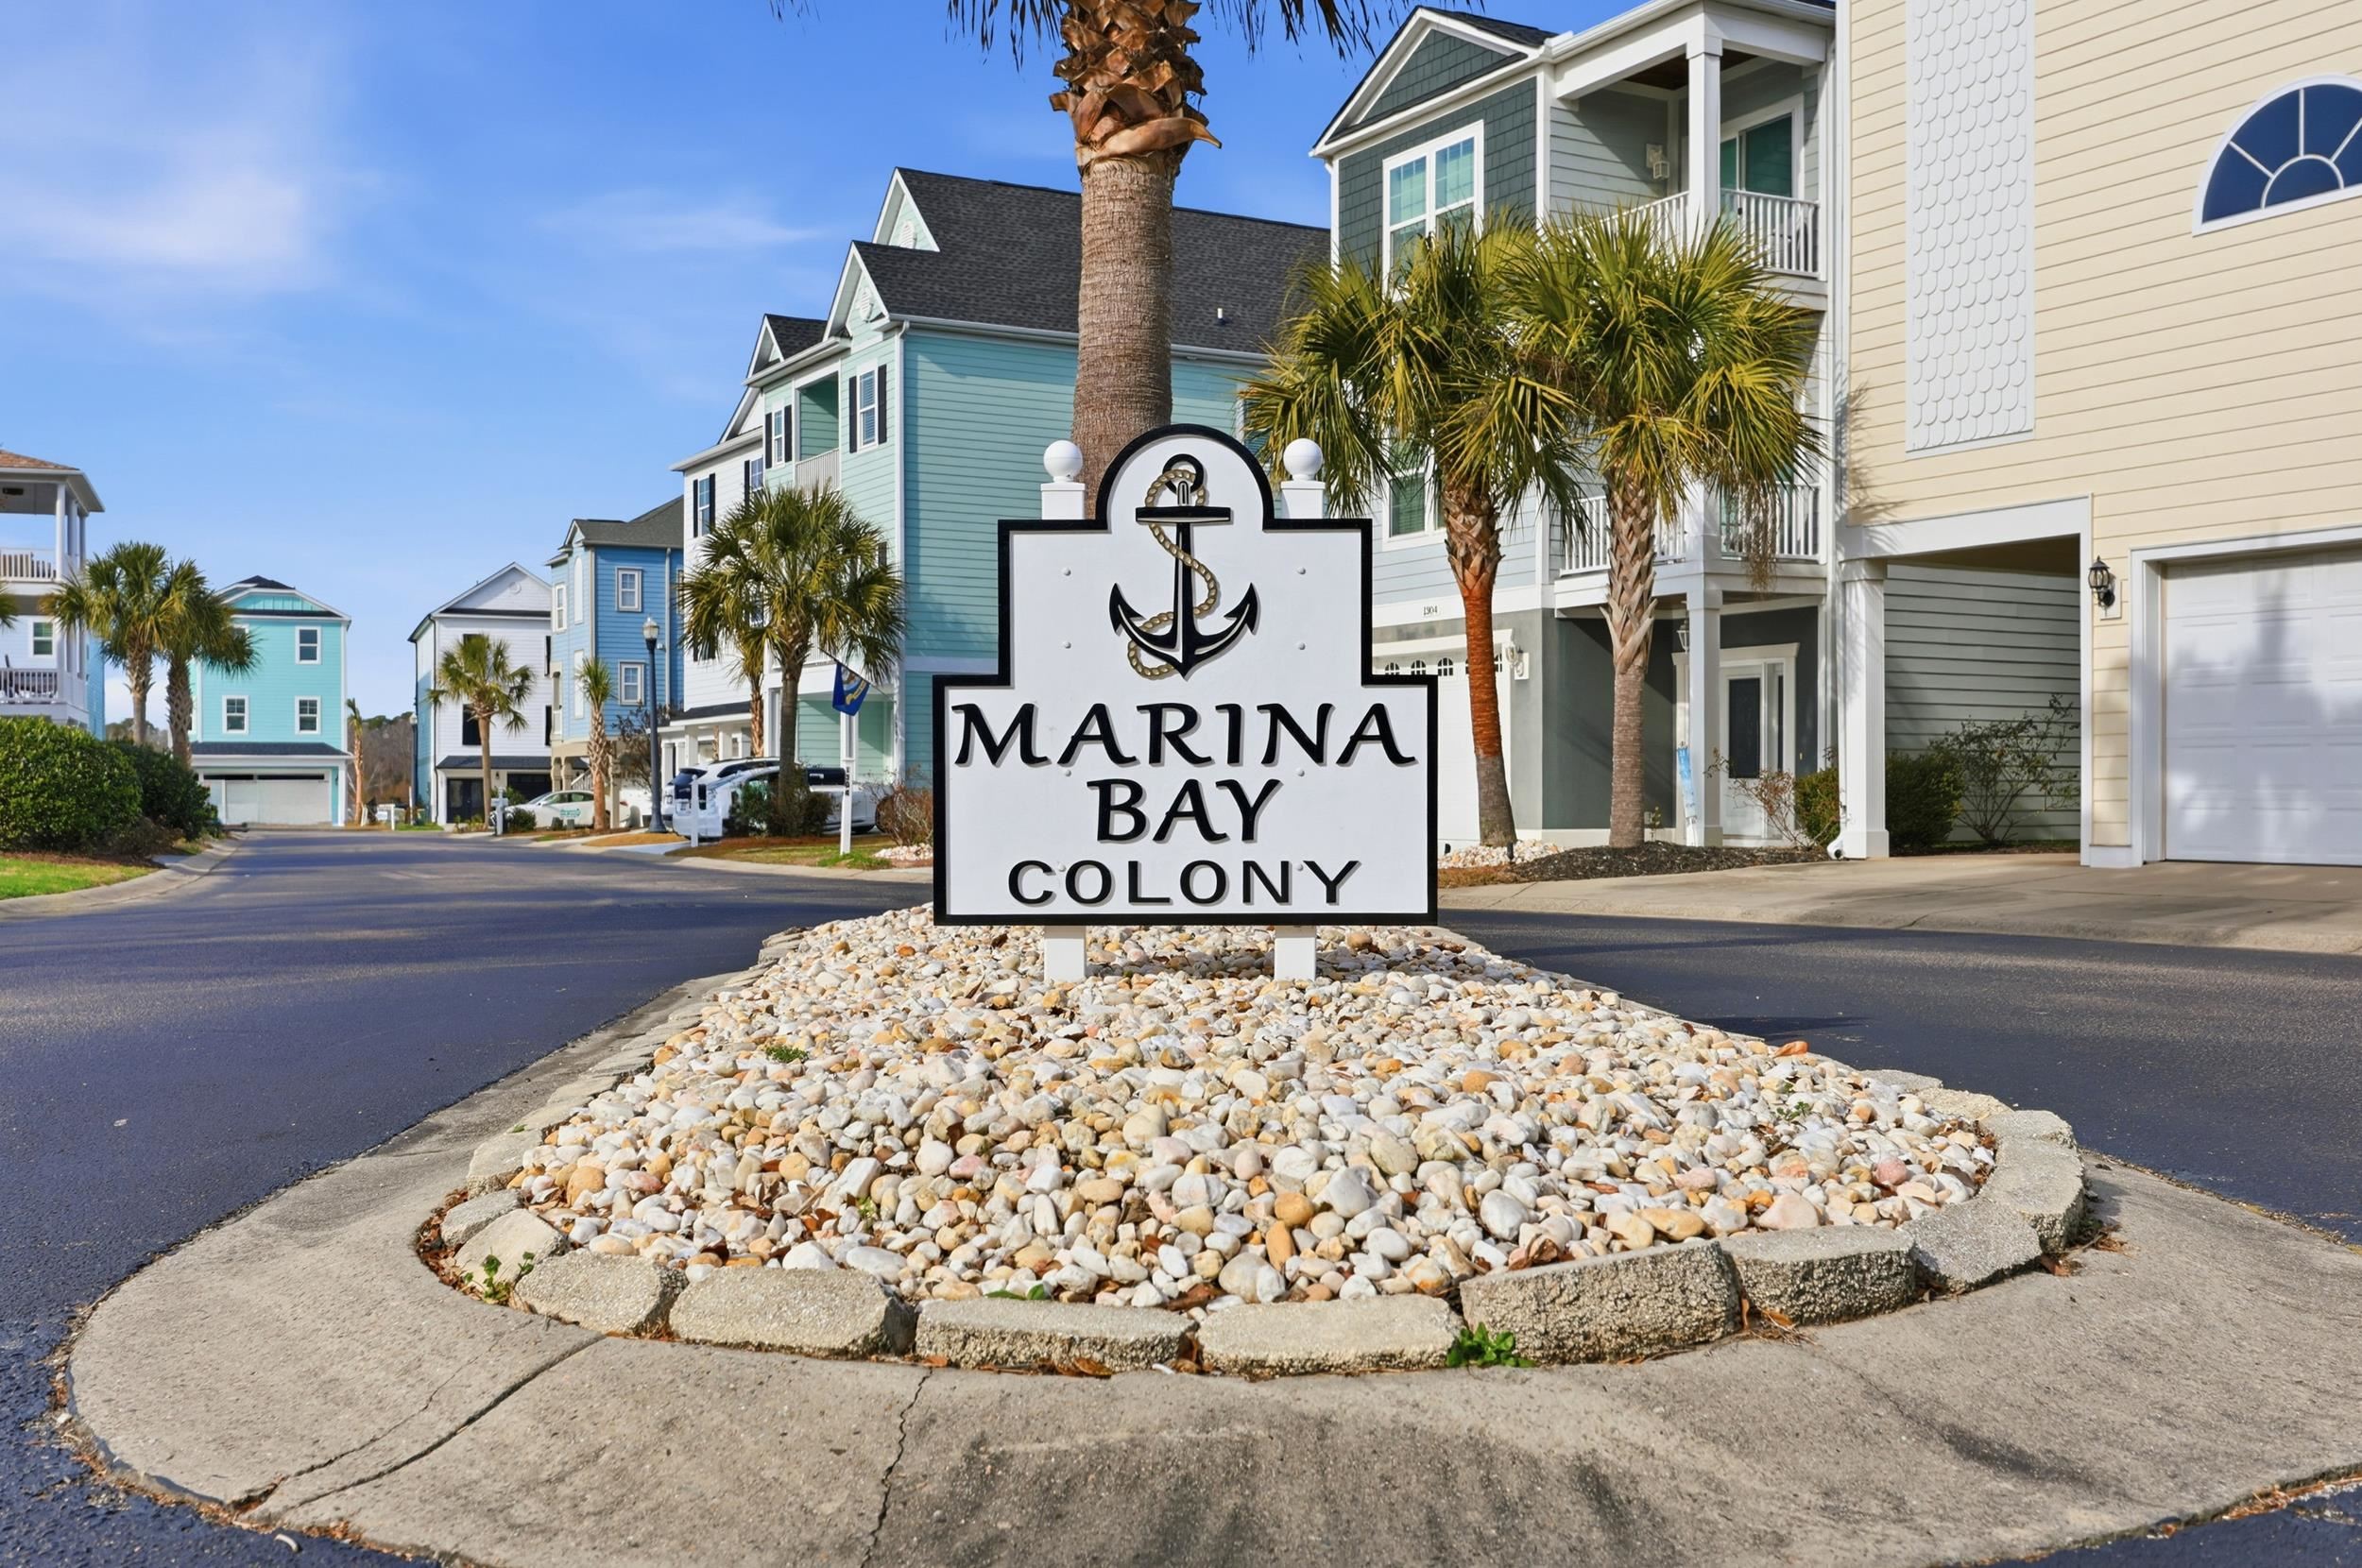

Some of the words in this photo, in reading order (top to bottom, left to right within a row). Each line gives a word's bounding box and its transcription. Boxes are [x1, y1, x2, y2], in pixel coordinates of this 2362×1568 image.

[951, 703, 1416, 766] MARINA
[1087, 778, 1282, 843] BAY
[1008, 860, 1361, 904] COLONY
